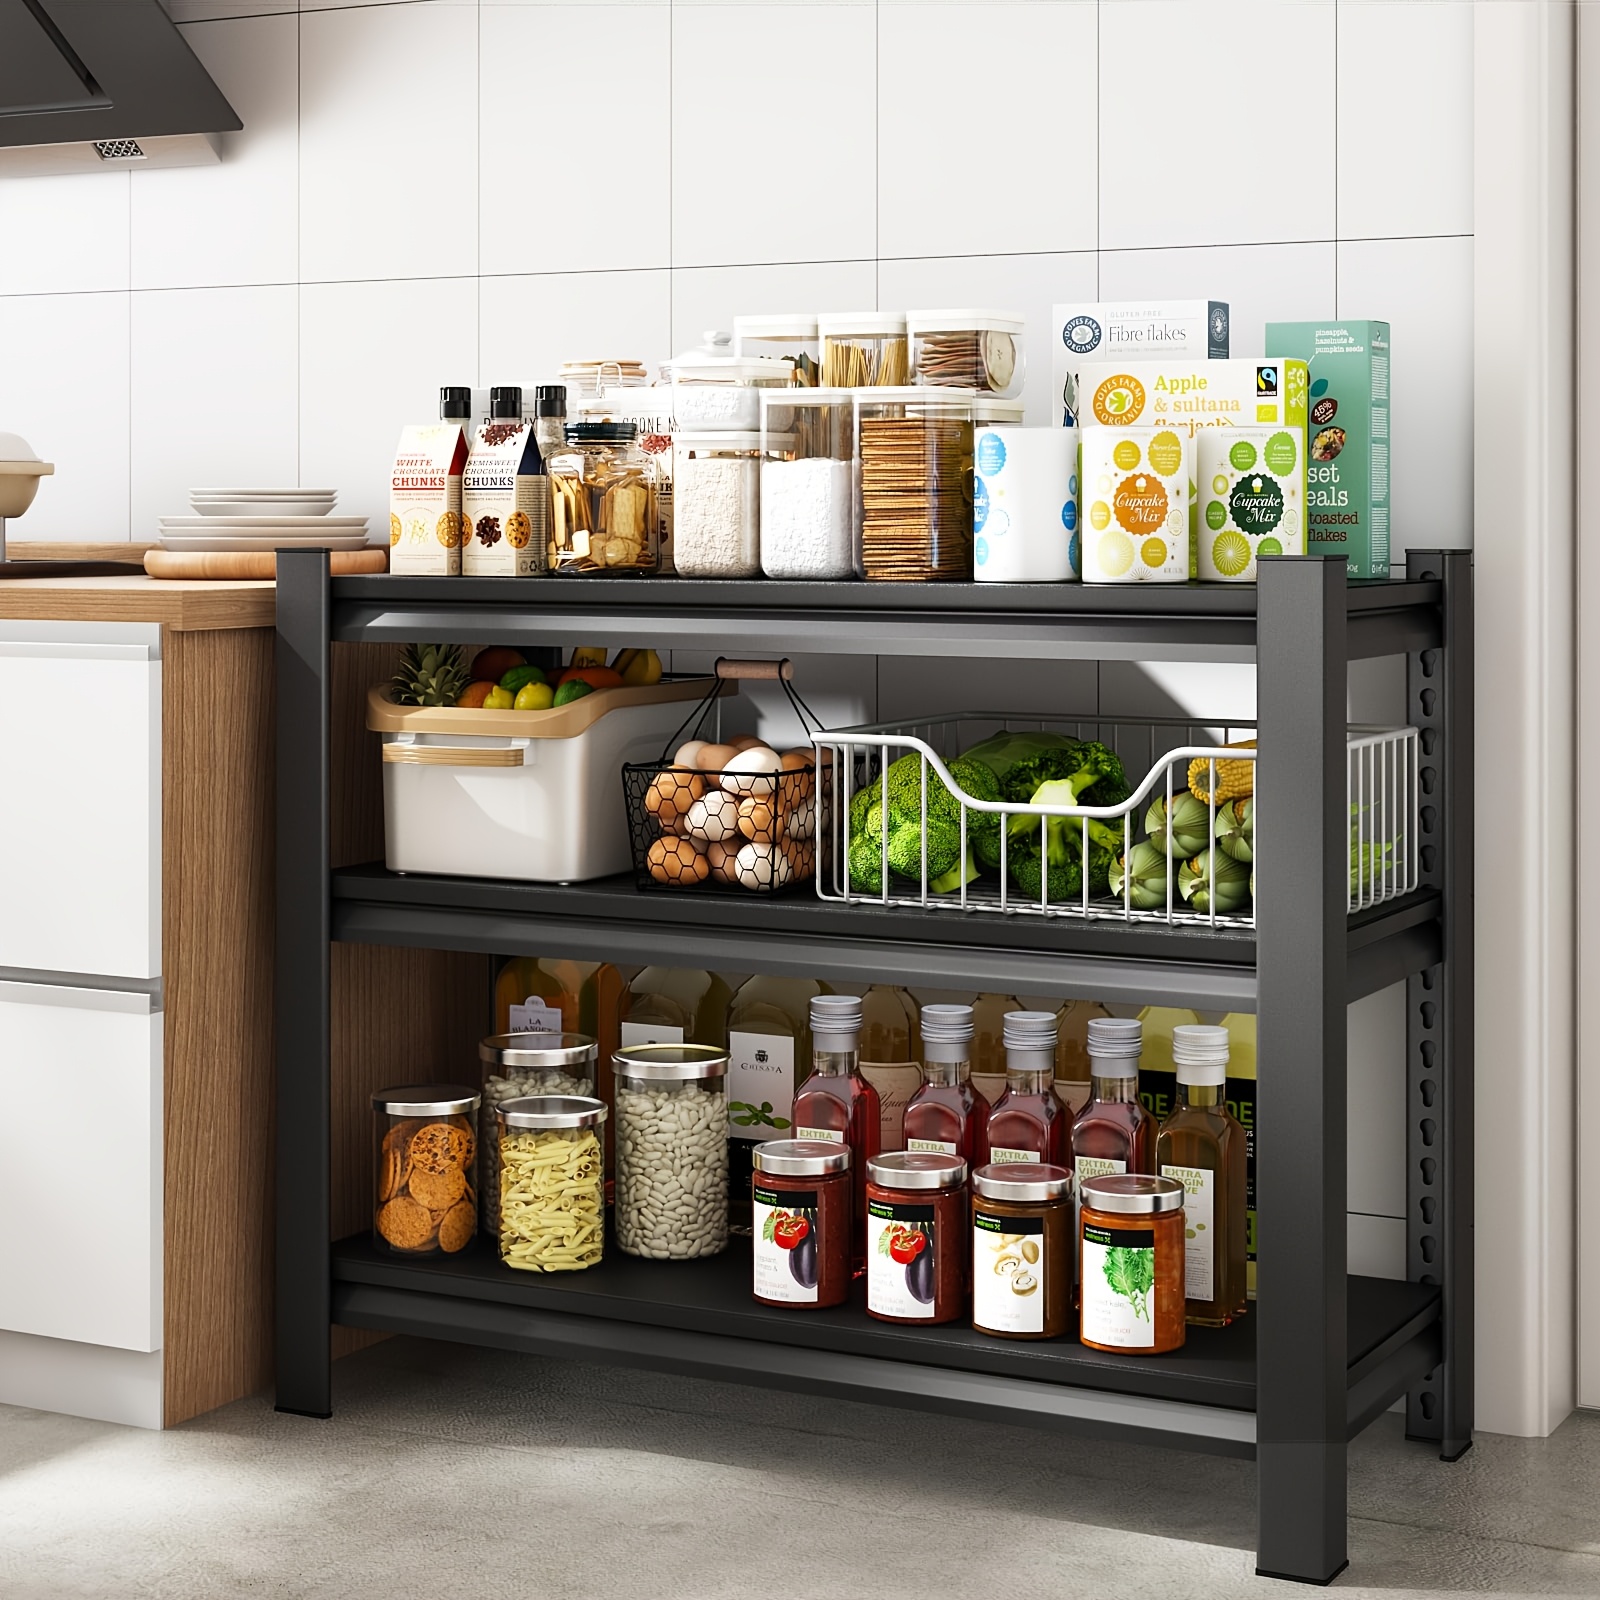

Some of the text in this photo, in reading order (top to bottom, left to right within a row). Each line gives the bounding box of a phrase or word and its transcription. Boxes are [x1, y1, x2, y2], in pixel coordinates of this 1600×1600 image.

[1064, 317, 1100, 337] DOVES FARM
[1109, 323, 1187, 343] Fibre flakes
[1065, 337, 1099, 353] ORGANIC
[1153, 374, 1208, 395] Apple
[1095, 377, 1143, 410] DOVES FARM
[1153, 396, 1241, 413] & sultana
[1100, 401, 1143, 426] ORGANIC
[396, 459, 433, 467] WHITE
[467, 459, 518, 467] SEMISWEET
[1307, 463, 1340, 483] set
[392, 476, 446, 487] CHUNKS
[463, 476, 514, 487] CHUNKS
[1116, 492, 1165, 511] Cupcake
[1232, 492, 1281, 511] Cupcake
[1129, 507, 1161, 523] Mix
[1245, 507, 1277, 523] Mix
[1309, 511, 1359, 525] toasted
[1307, 528, 1347, 542] flakes
[528, 1017, 542, 1026] LA
[740, 1062, 783, 1074] CHINATA
[800, 1128, 833, 1140] EXTRA
[911, 1140, 946, 1152] EXTRA
[993, 1150, 1029, 1161] EXTRA
[1078, 1159, 1115, 1170] EXTRA
[1164, 1167, 1202, 1179] EXTRA
